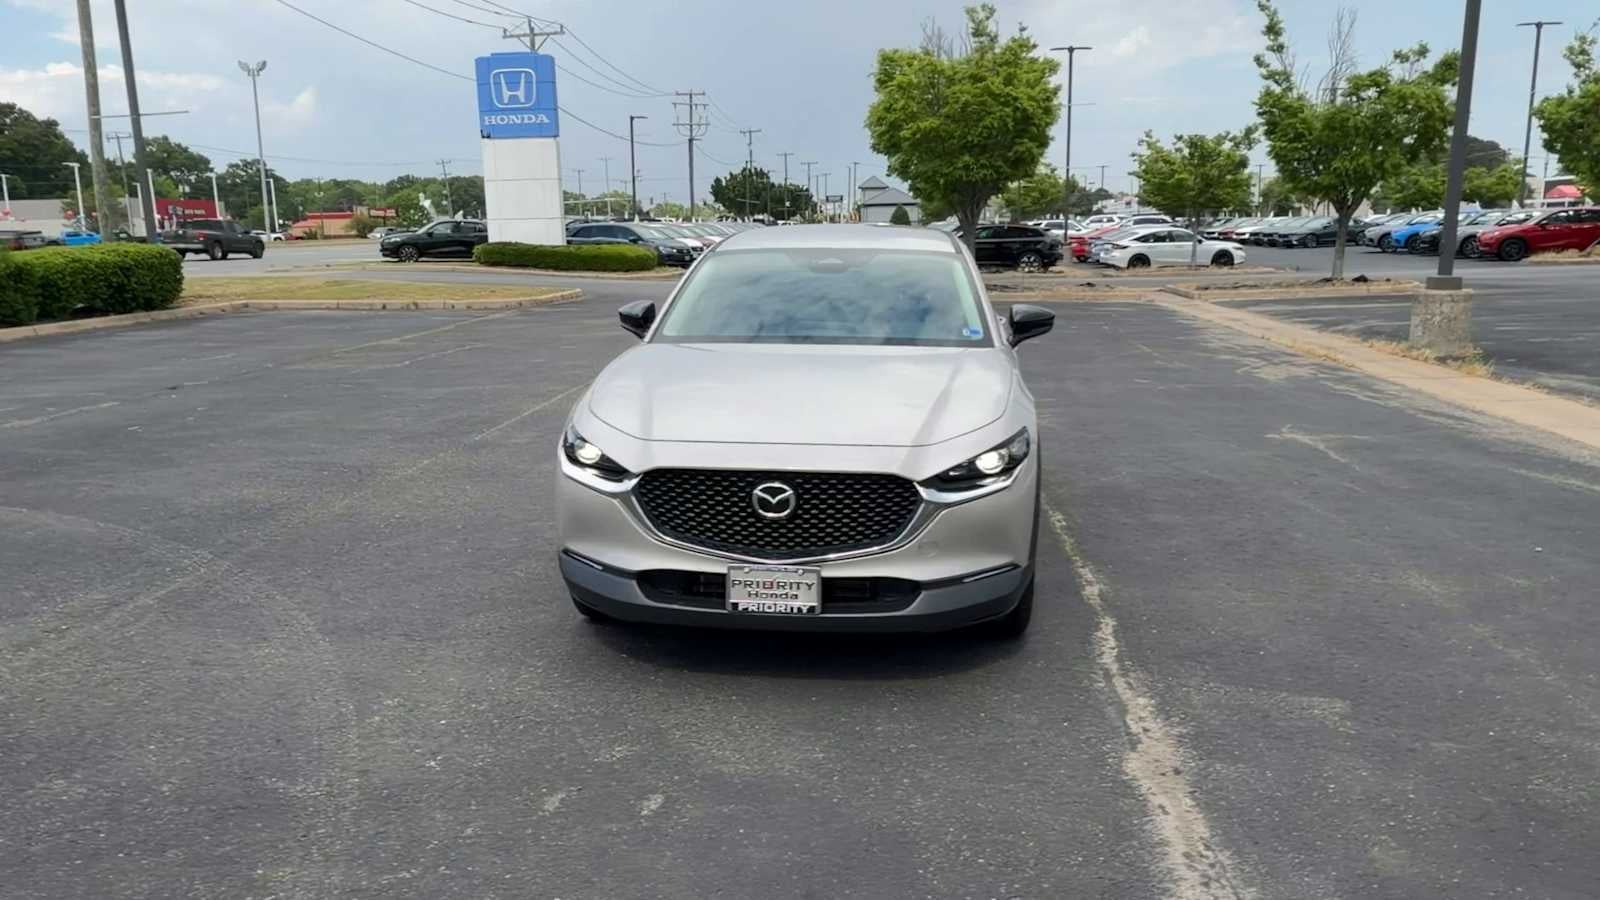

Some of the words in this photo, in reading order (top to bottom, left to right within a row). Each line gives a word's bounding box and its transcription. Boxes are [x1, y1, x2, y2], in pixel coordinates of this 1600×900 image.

[484, 113, 550, 125] HONDA
[731, 579, 816, 590] PRIORITY
[748, 590, 799, 600] Honda
[738, 602, 811, 613] PRIORITY
